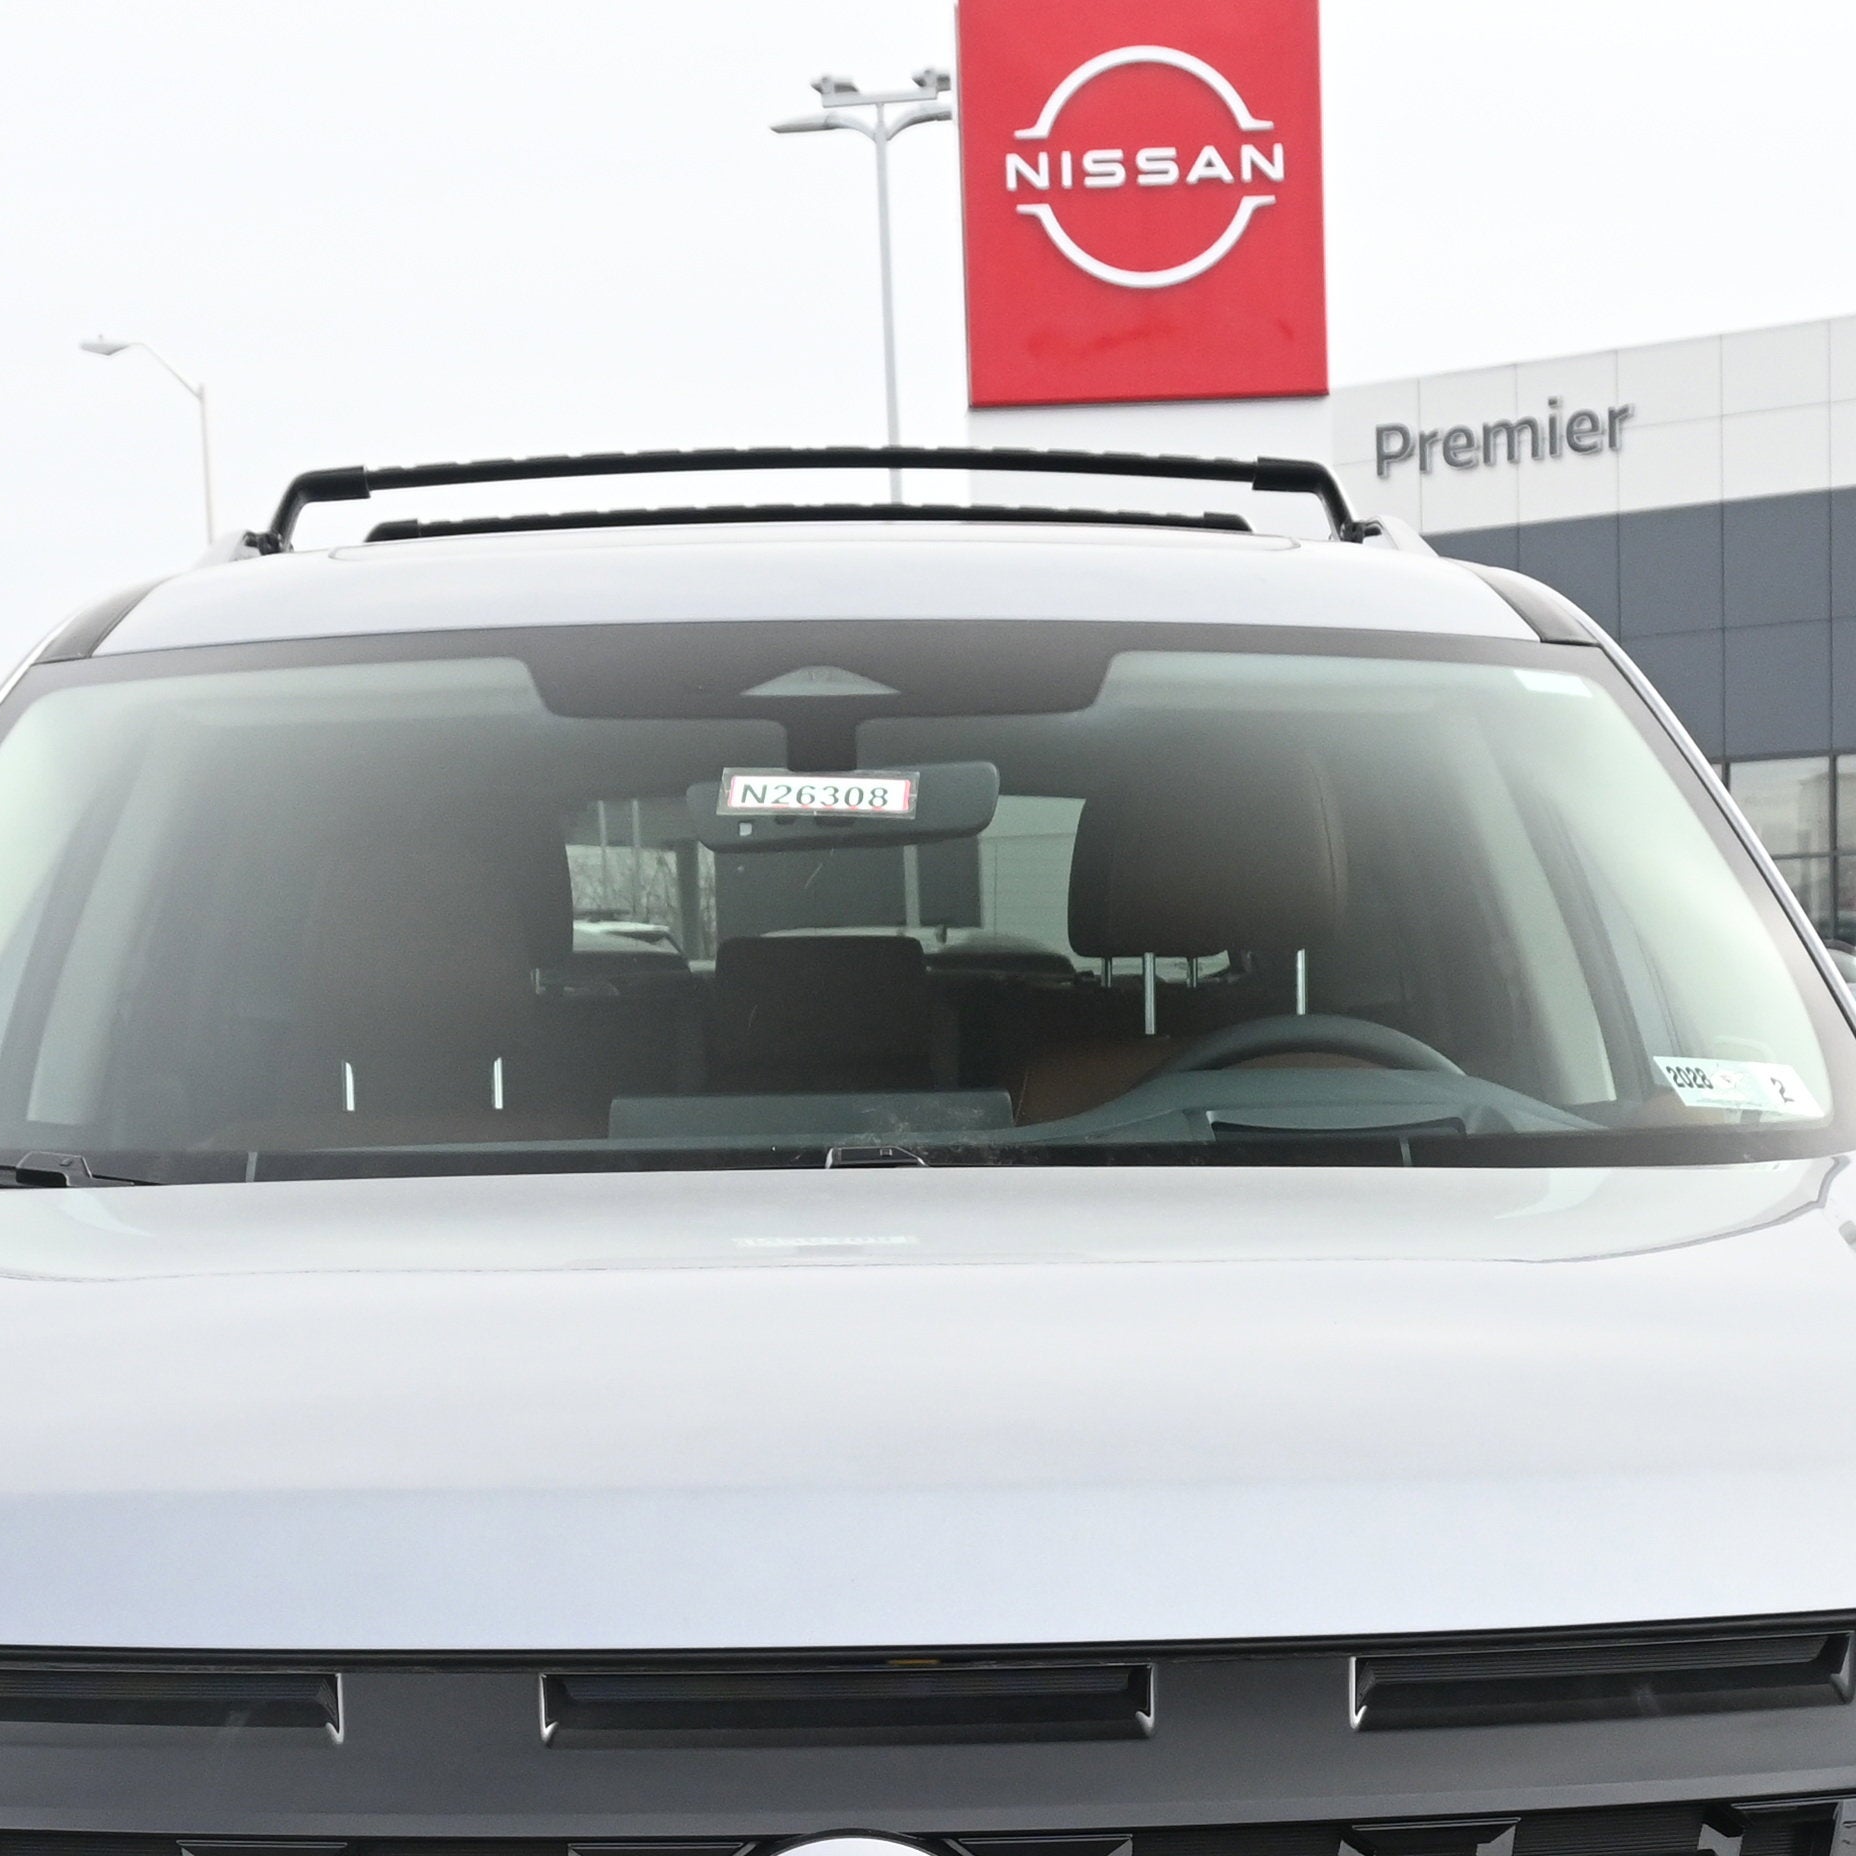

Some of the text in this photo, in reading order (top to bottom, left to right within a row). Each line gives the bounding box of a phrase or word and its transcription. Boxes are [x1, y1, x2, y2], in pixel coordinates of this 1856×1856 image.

[1005, 143, 1285, 191] NISSAN
[1375, 396, 1634, 478] Premier
[740, 784, 889, 808] N26308
[1665, 1066, 1714, 1090] 2028
